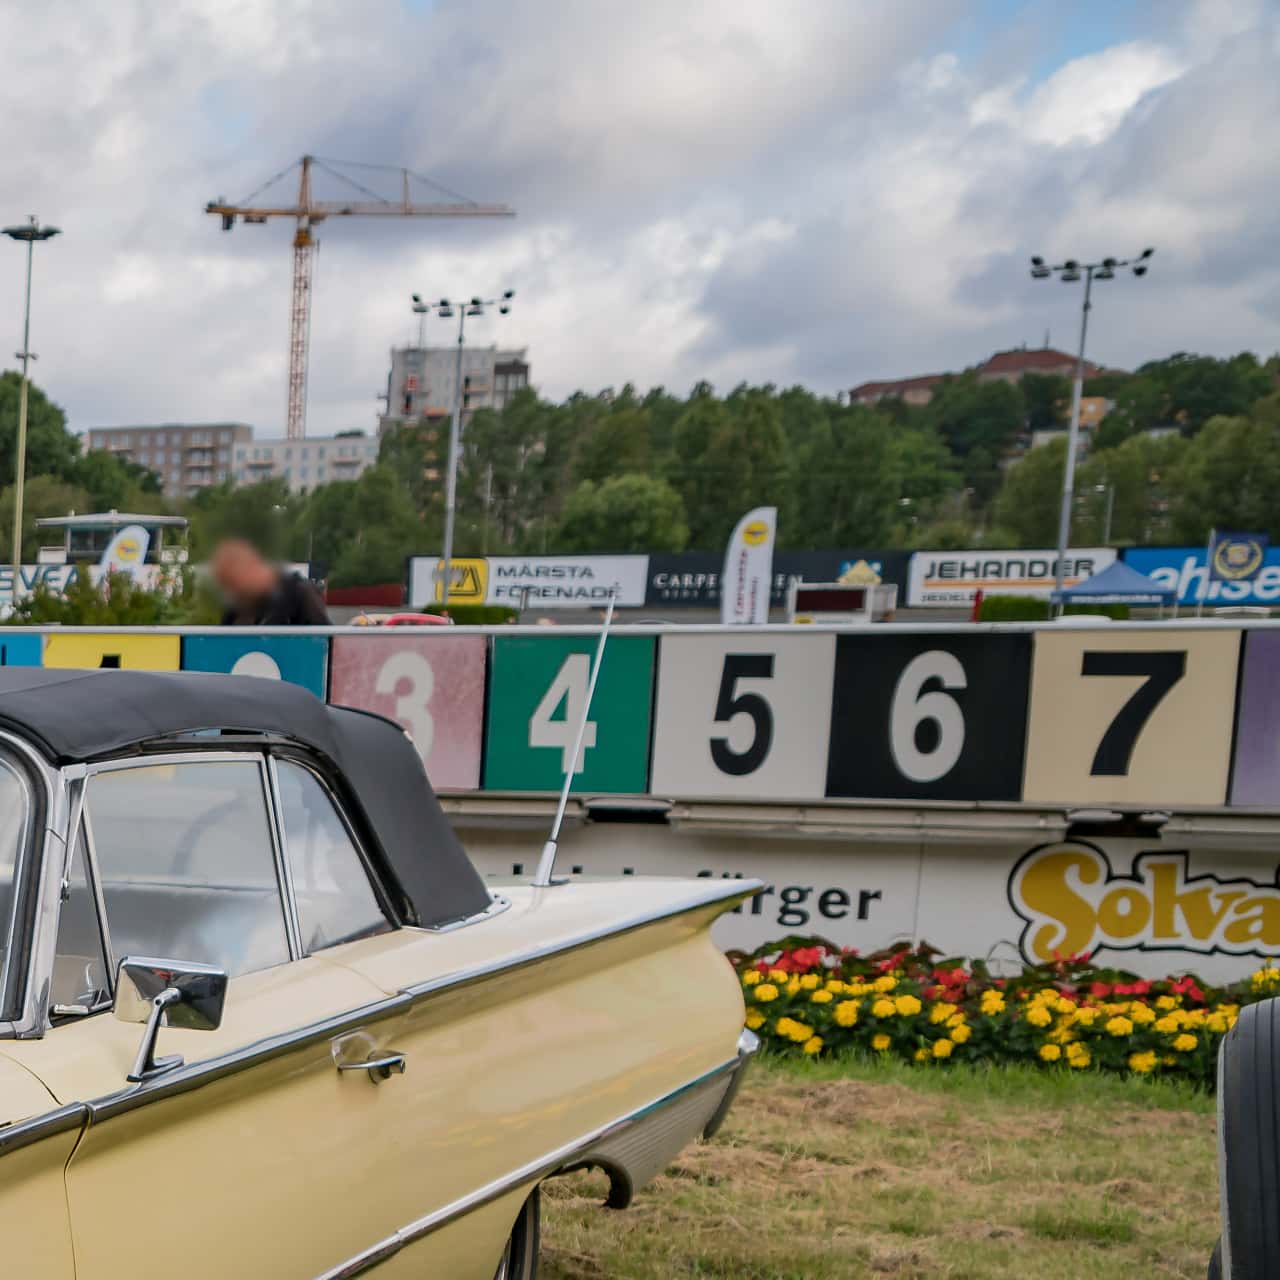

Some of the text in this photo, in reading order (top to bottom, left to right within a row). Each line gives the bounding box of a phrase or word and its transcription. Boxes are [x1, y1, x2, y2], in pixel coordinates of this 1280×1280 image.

[925, 559, 1095, 580] JEHANDER
[528, 653, 597, 774] 4
[709, 653, 775, 776] 5
[889, 650, 968, 783] 6
[1080, 650, 1188, 776] 7
